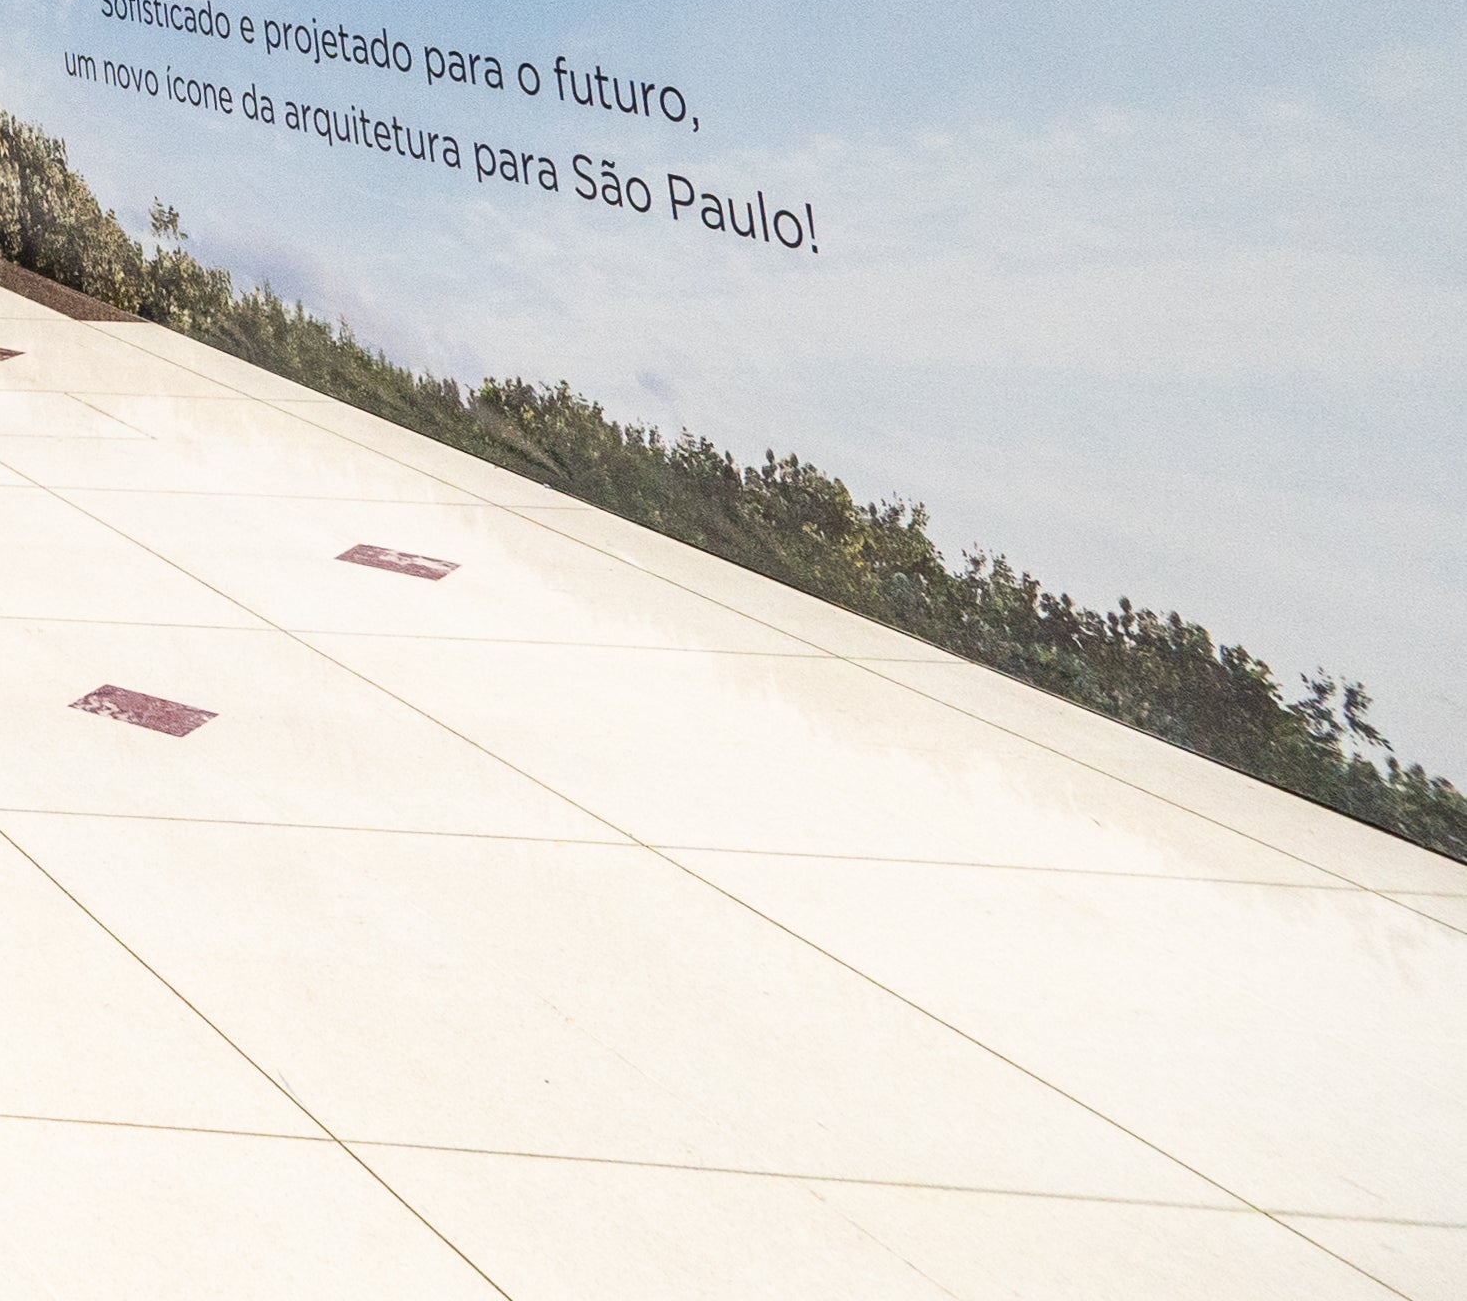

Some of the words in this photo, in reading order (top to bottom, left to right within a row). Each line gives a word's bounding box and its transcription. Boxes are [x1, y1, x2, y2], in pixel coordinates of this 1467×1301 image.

[65, 53, 96, 81] um
[104, 61, 158, 96] novo
[167, 66, 232, 114] ícone
[242, 84, 275, 124] da
[285, 101, 461, 169] arquitetura
[474, 142, 559, 192] para
[572, 154, 652, 213] São
[667, 173, 818, 254] Paulo!
[264, 18, 412, 72] projetado
[424, 47, 504, 89] para
[553, 56, 699, 132] futuro,
